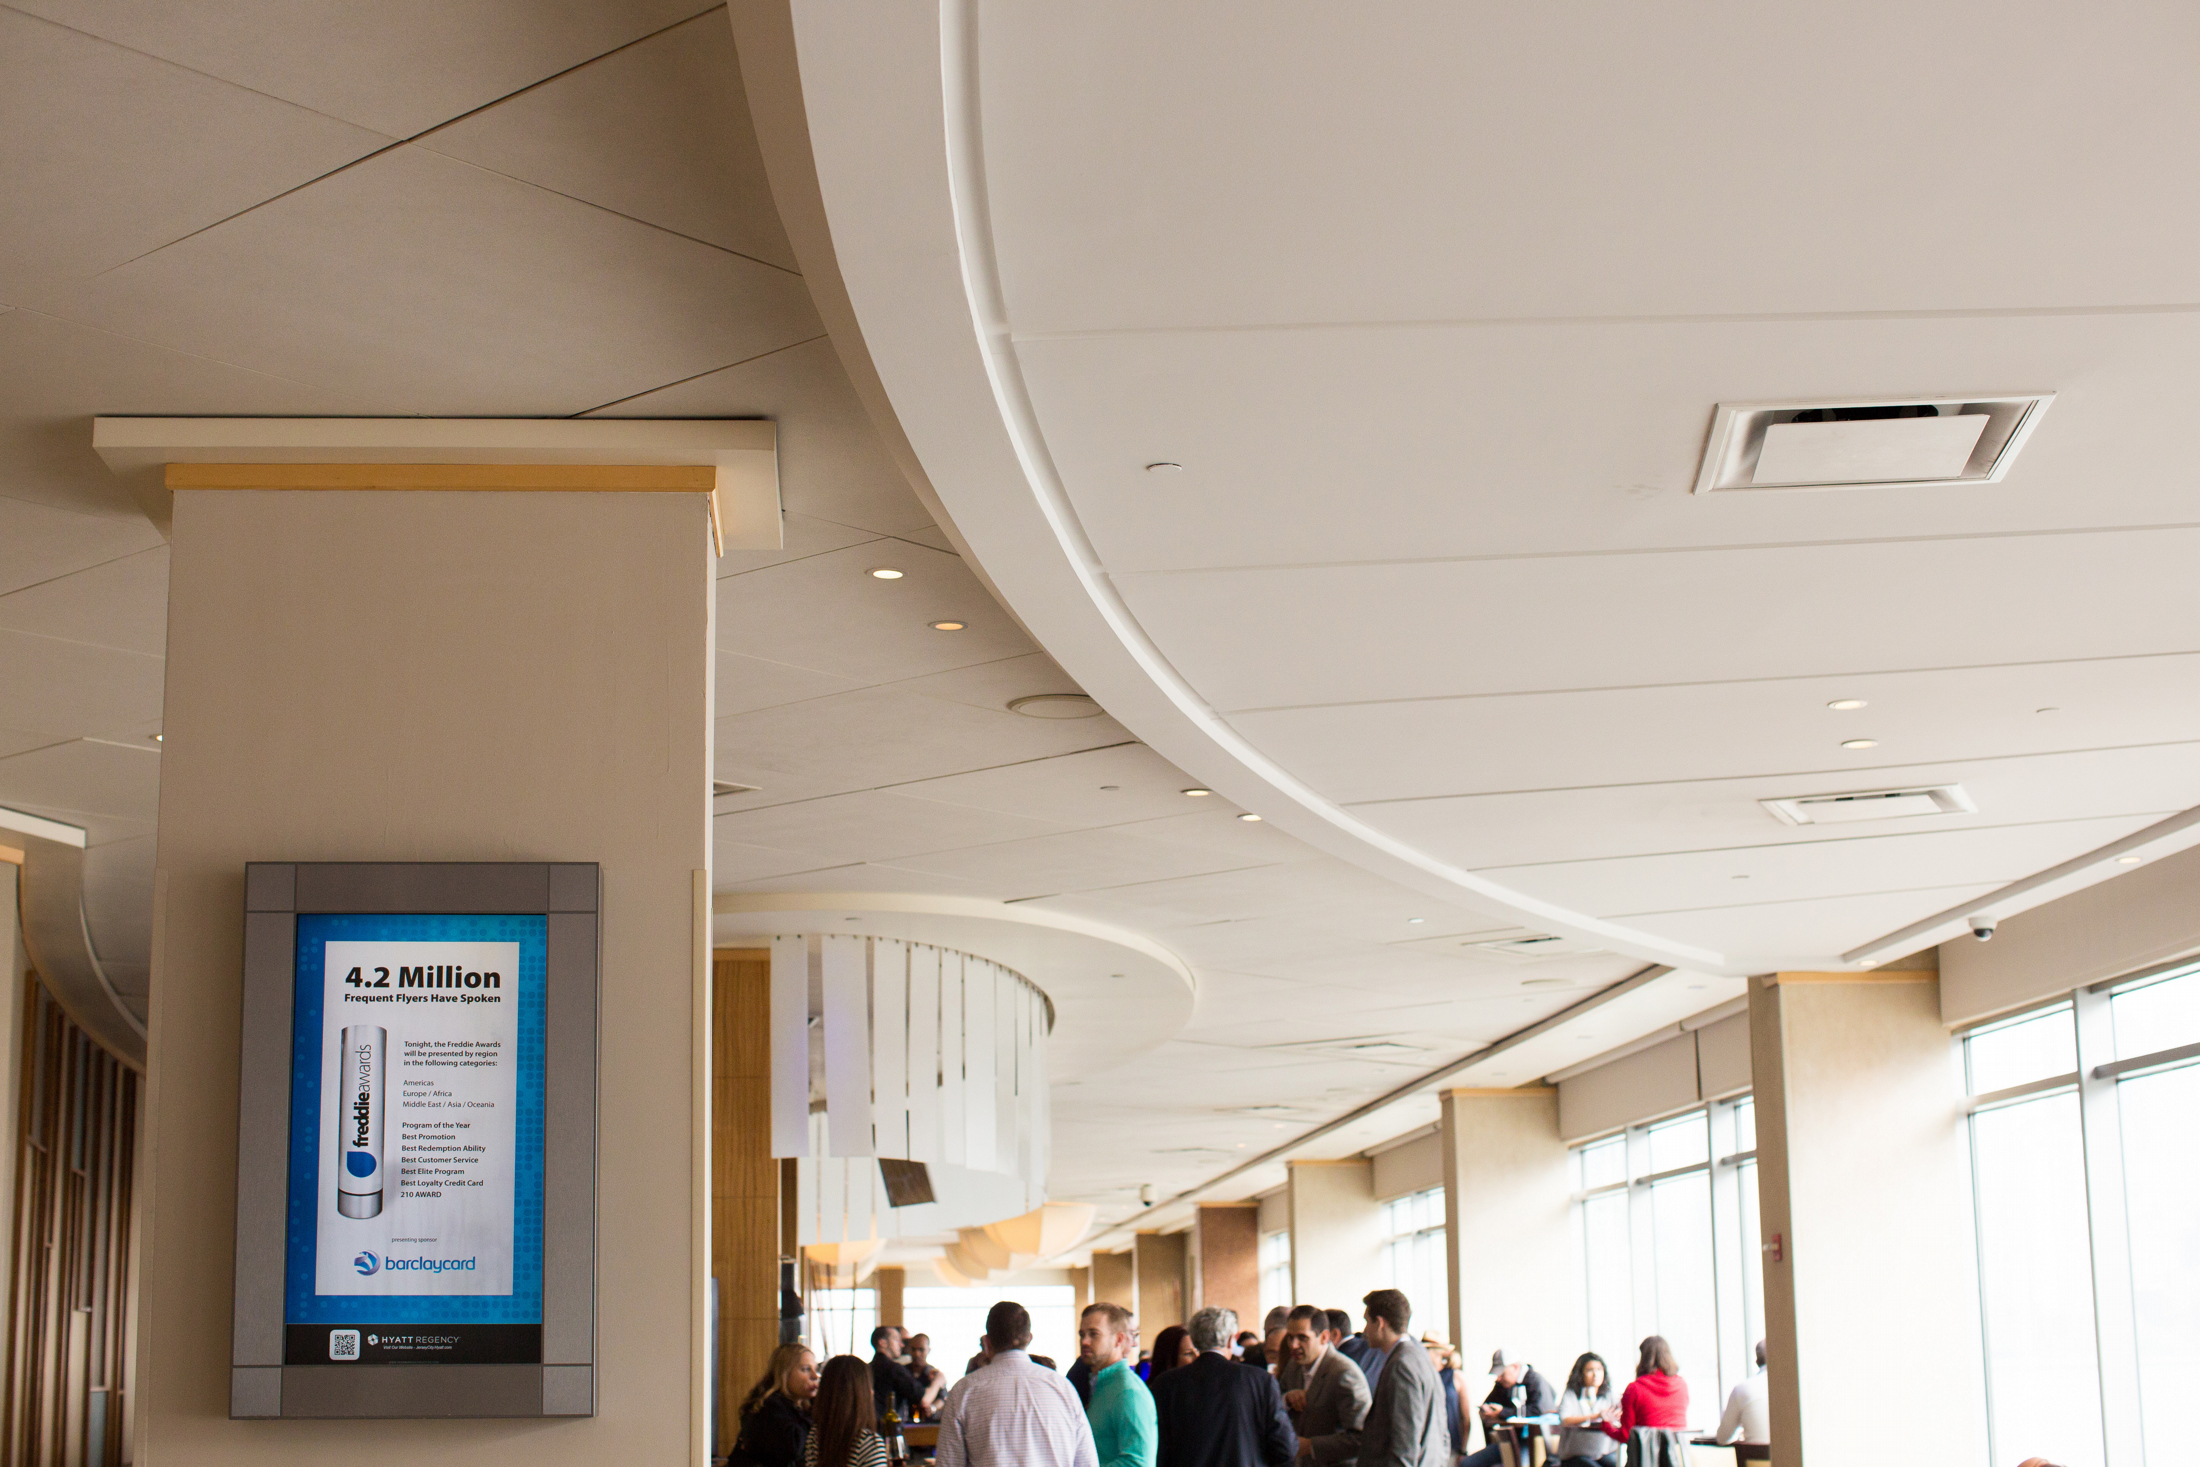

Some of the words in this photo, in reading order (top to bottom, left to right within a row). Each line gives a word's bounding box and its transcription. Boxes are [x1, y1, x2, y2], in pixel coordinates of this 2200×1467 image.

[345, 966, 390, 988] 4.2
[399, 965, 501, 988] Million
[344, 993, 394, 1004] Frequent
[396, 993, 428, 1004] Flyers
[431, 994, 458, 1002] Have
[460, 994, 501, 1004] Spoken
[404, 1041, 433, 1049] Tonight,
[428, 1050, 463, 1058] presented
[465, 1050, 473, 1058] by
[475, 1050, 498, 1058] region
[353, 1044, 372, 1147] freddieawards
[403, 1090, 427, 1098] Europe
[402, 1122, 432, 1130] Program
[418, 1145, 461, 1153] Redemption
[463, 1145, 486, 1153] Ability
[434, 1168, 465, 1176] Program
[385, 1256, 476, 1274] barclaycard
[382, 1336, 414, 1344] HYATT
[416, 1336, 460, 1344] REGENCY
